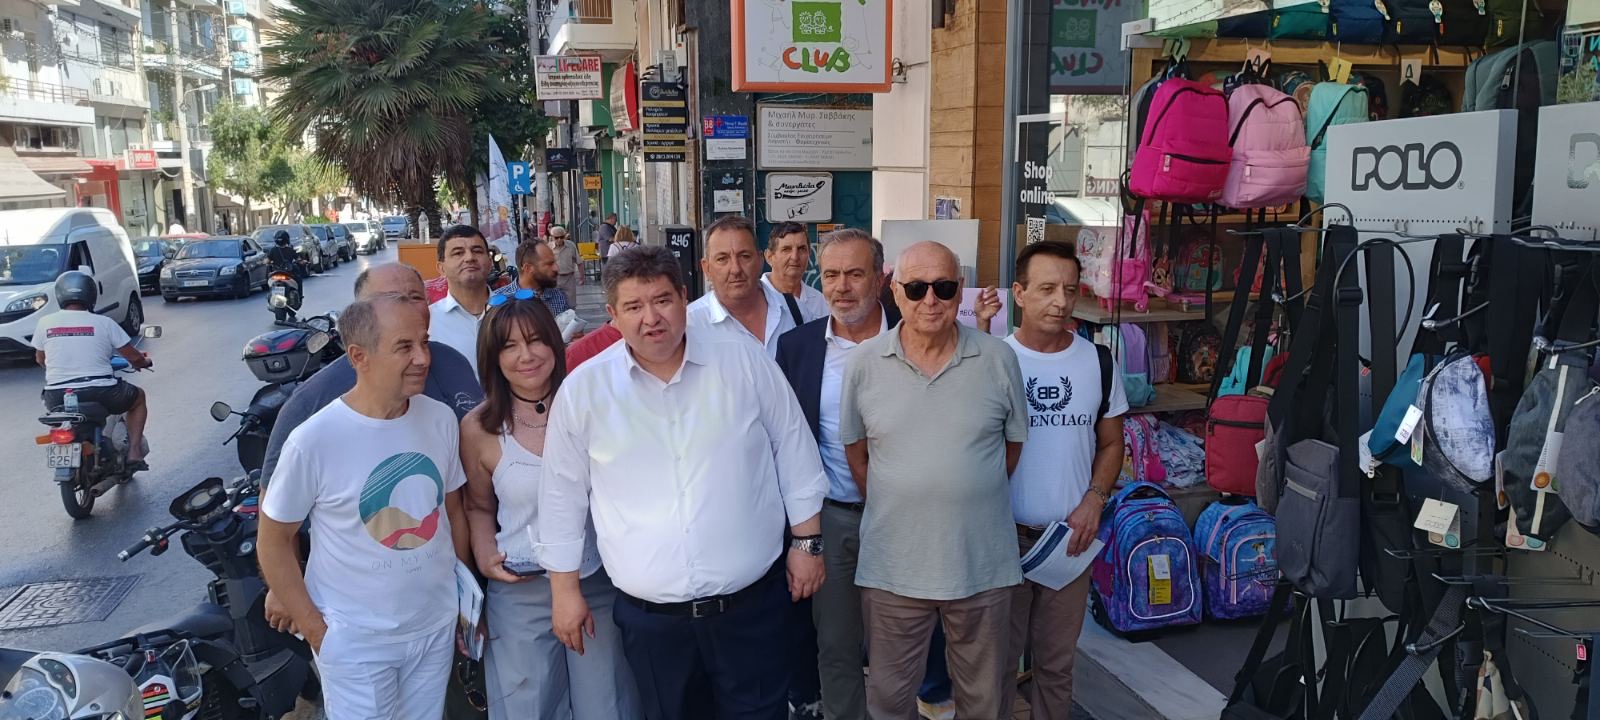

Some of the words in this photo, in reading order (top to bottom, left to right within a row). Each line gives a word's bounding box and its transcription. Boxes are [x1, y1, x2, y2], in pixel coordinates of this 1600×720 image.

[783, 47, 850, 73] CLUB
[768, 111, 796, 121] Μιχαήλ
[819, 111, 856, 122] Σαββάκης
[512, 164, 524, 179] P
[1024, 161, 1053, 183] Shop
[1352, 141, 1463, 191] POLO
[1020, 186, 1056, 205] online
[671, 233, 690, 247] 246
[50, 456, 70, 466] 626
